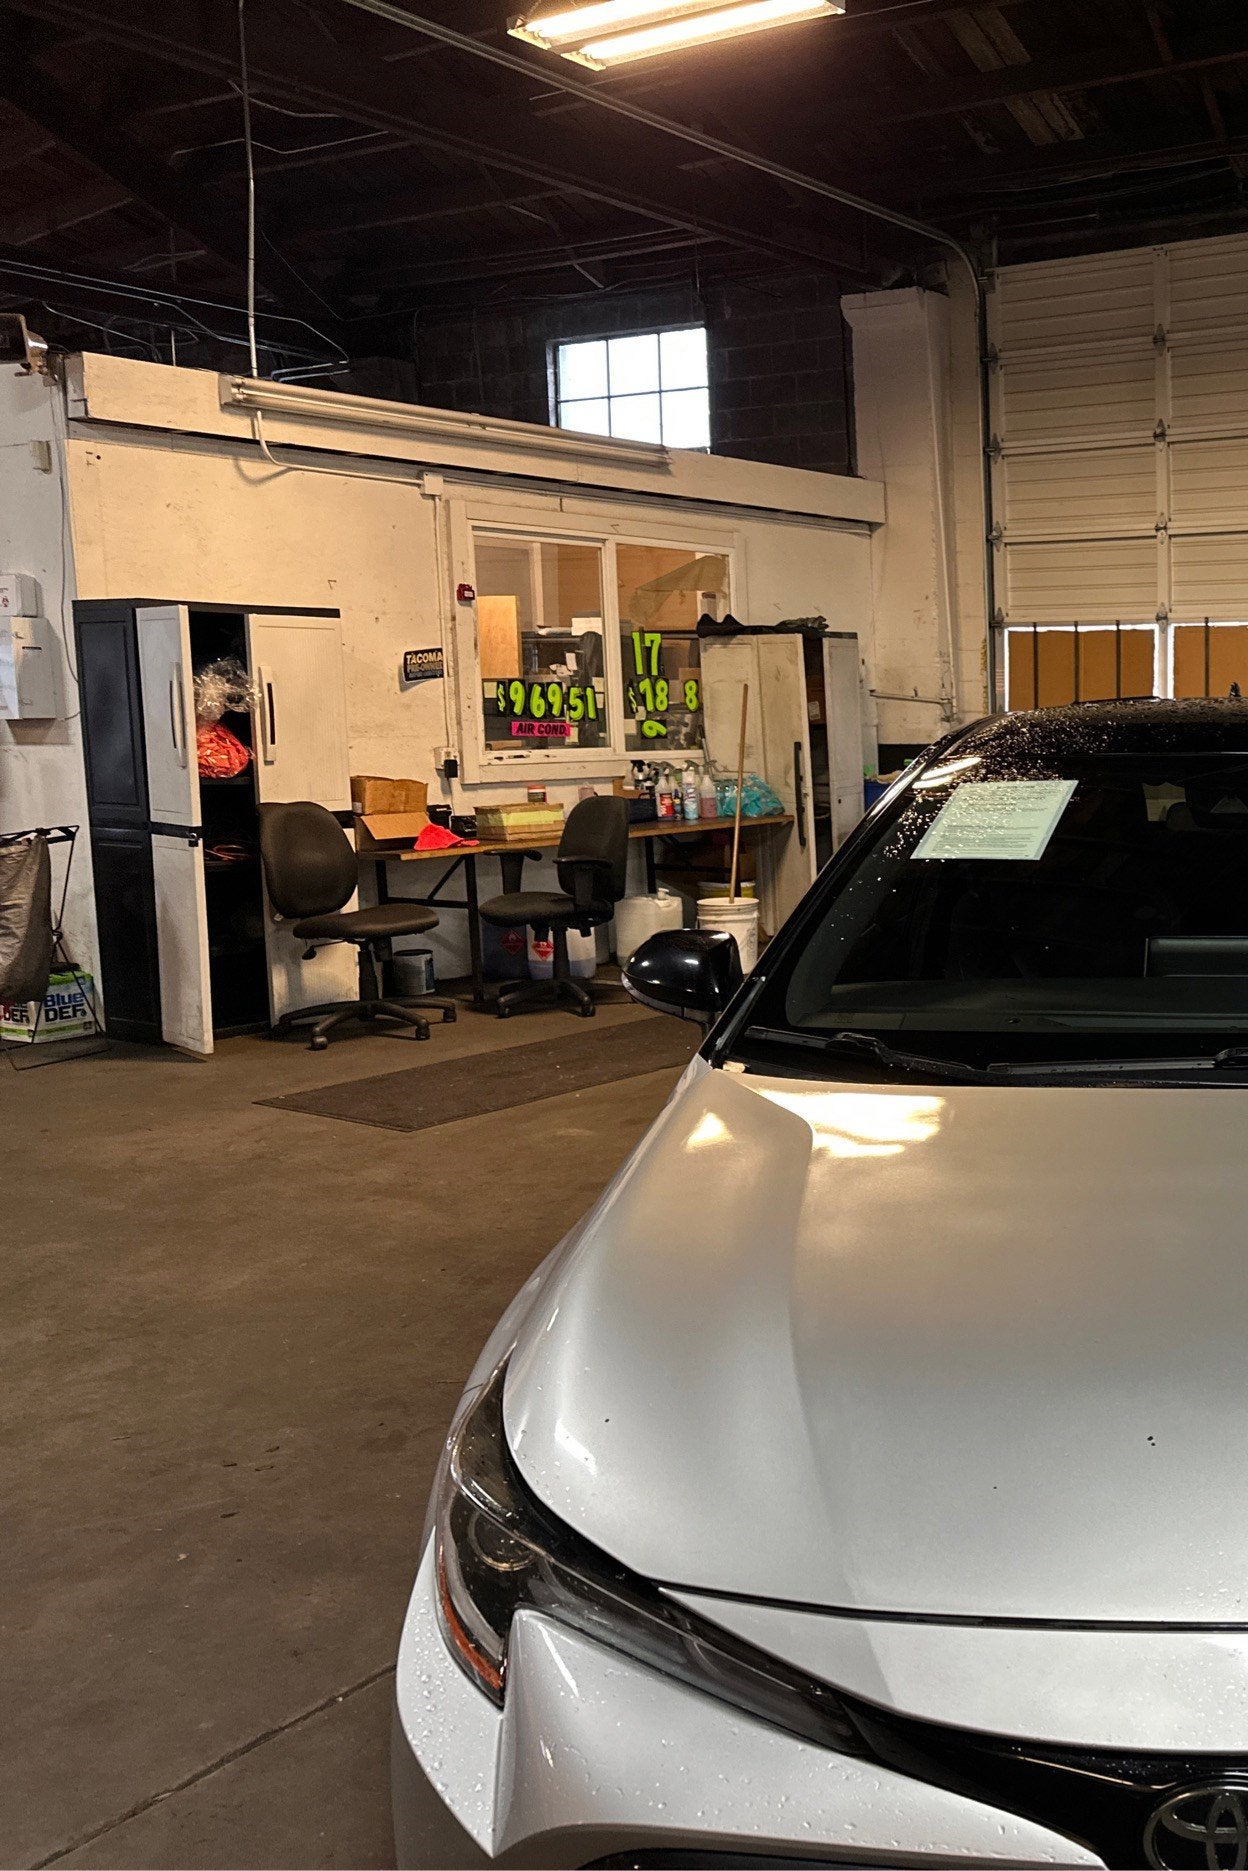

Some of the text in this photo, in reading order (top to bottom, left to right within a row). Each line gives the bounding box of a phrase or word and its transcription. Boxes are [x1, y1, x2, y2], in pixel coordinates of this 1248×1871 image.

[406, 651, 443, 665] TACOMA
[631, 631, 662, 676] 17
[516, 723, 535, 735] AIR
[44, 1003, 84, 1023] DEF
